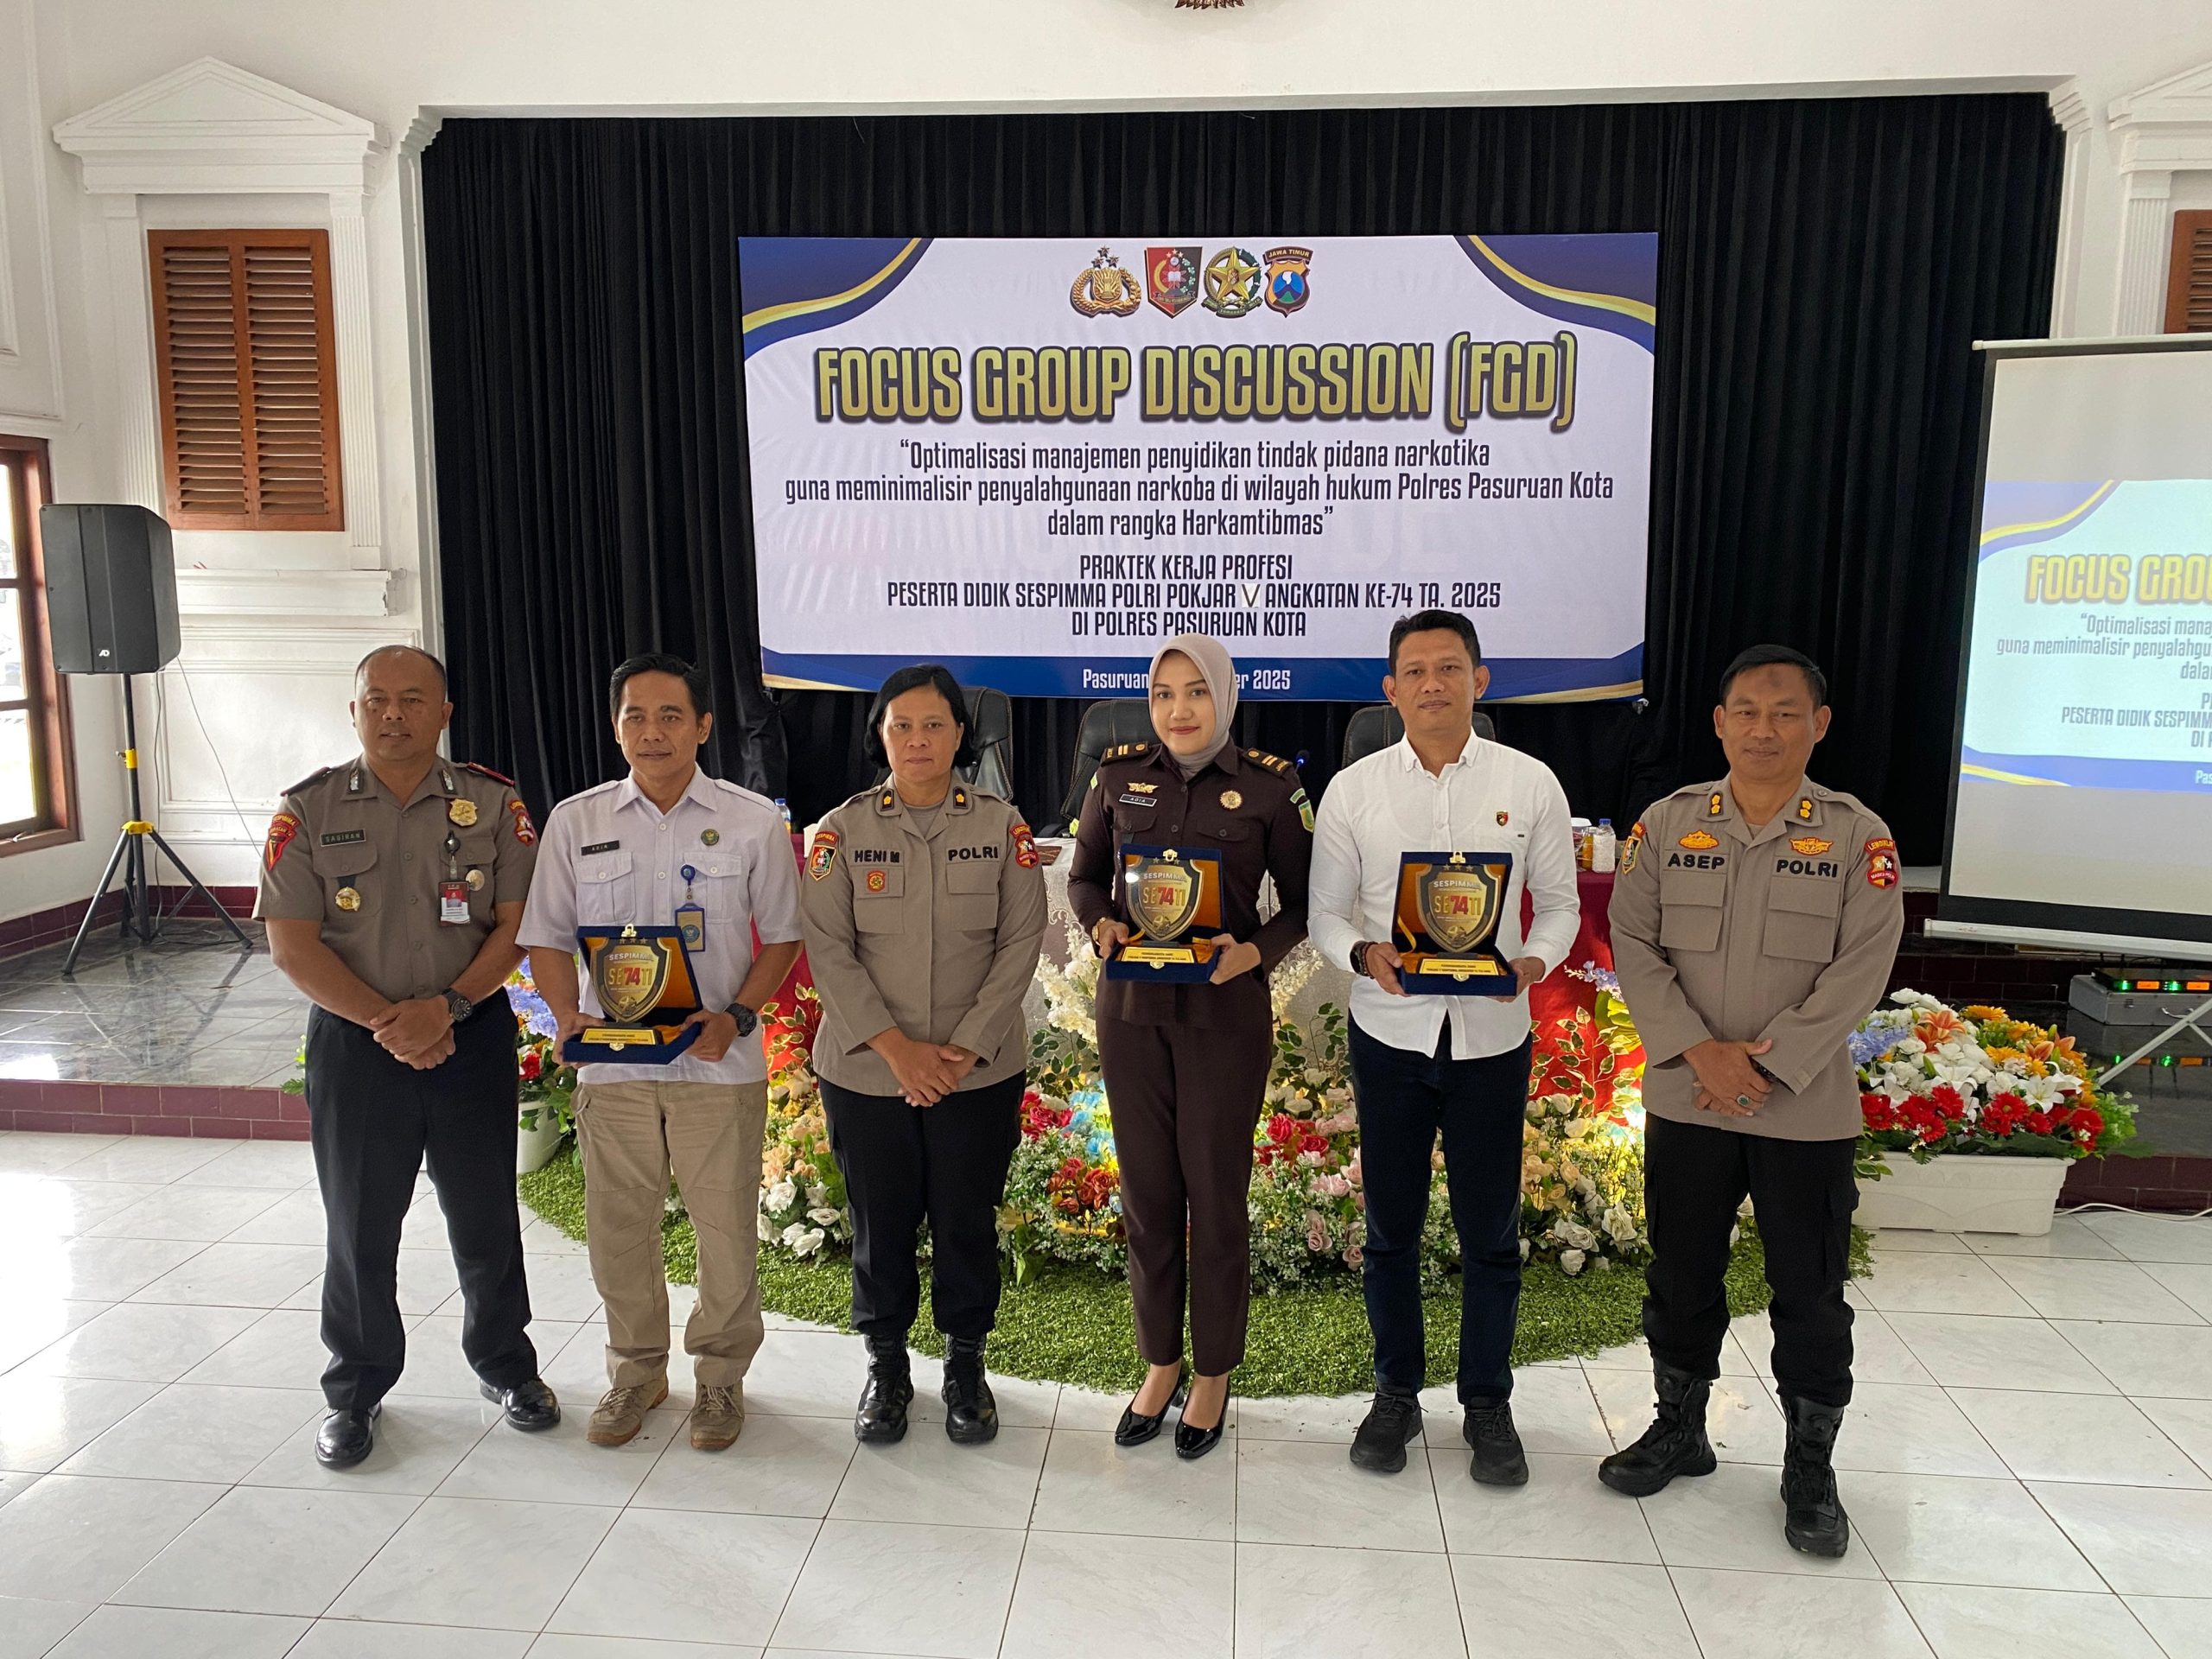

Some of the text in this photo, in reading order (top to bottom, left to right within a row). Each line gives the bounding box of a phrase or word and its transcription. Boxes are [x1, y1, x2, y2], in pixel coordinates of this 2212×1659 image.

[1268, 249, 1309, 258] JAWA TIMUR
[816, 332, 1577, 433] FOCUS GROUP DISCUSSION (FGD)
[901, 439, 1489, 475] “Optimalisasi manajemen penyidikan tindak pidana narkotika
[786, 472, 1612, 505] guna meminimalisir penyalahgunaan narkoba di wilayah hukum Polres Pasuruan Kota
[1049, 504, 1332, 539] dalam rangka Harkamtibmas”
[1081, 555, 1292, 580] PRAKTEK KERJA PROFESI
[2024, 554, 2132, 604] FOCUS
[888, 582, 1500, 607] PESERTA DIDIK SESPIMMA POLRI POKJAR V ANGKATAN KE-74 TA. 2025
[1072, 612, 1306, 636] DI POLRES PASURUAN KOTA
[2081, 613, 2212, 639] “Optimalisasi mana
[1997, 636, 2212, 659] guna meminimalisir penyalahgu
[1083, 669, 1149, 690] Pasuruan
[1253, 670, 1291, 690] 2025
[2180, 661, 2212, 680] dala
[2062, 707, 2212, 728] PESERTA DIDIK SESPIMM
[2191, 730, 2204, 747] DI
[854, 849, 899, 863] HENI M
[948, 846, 998, 861] POLRI
[1668, 853, 1725, 870] ASEP
[1776, 859, 1838, 878] POLRI
